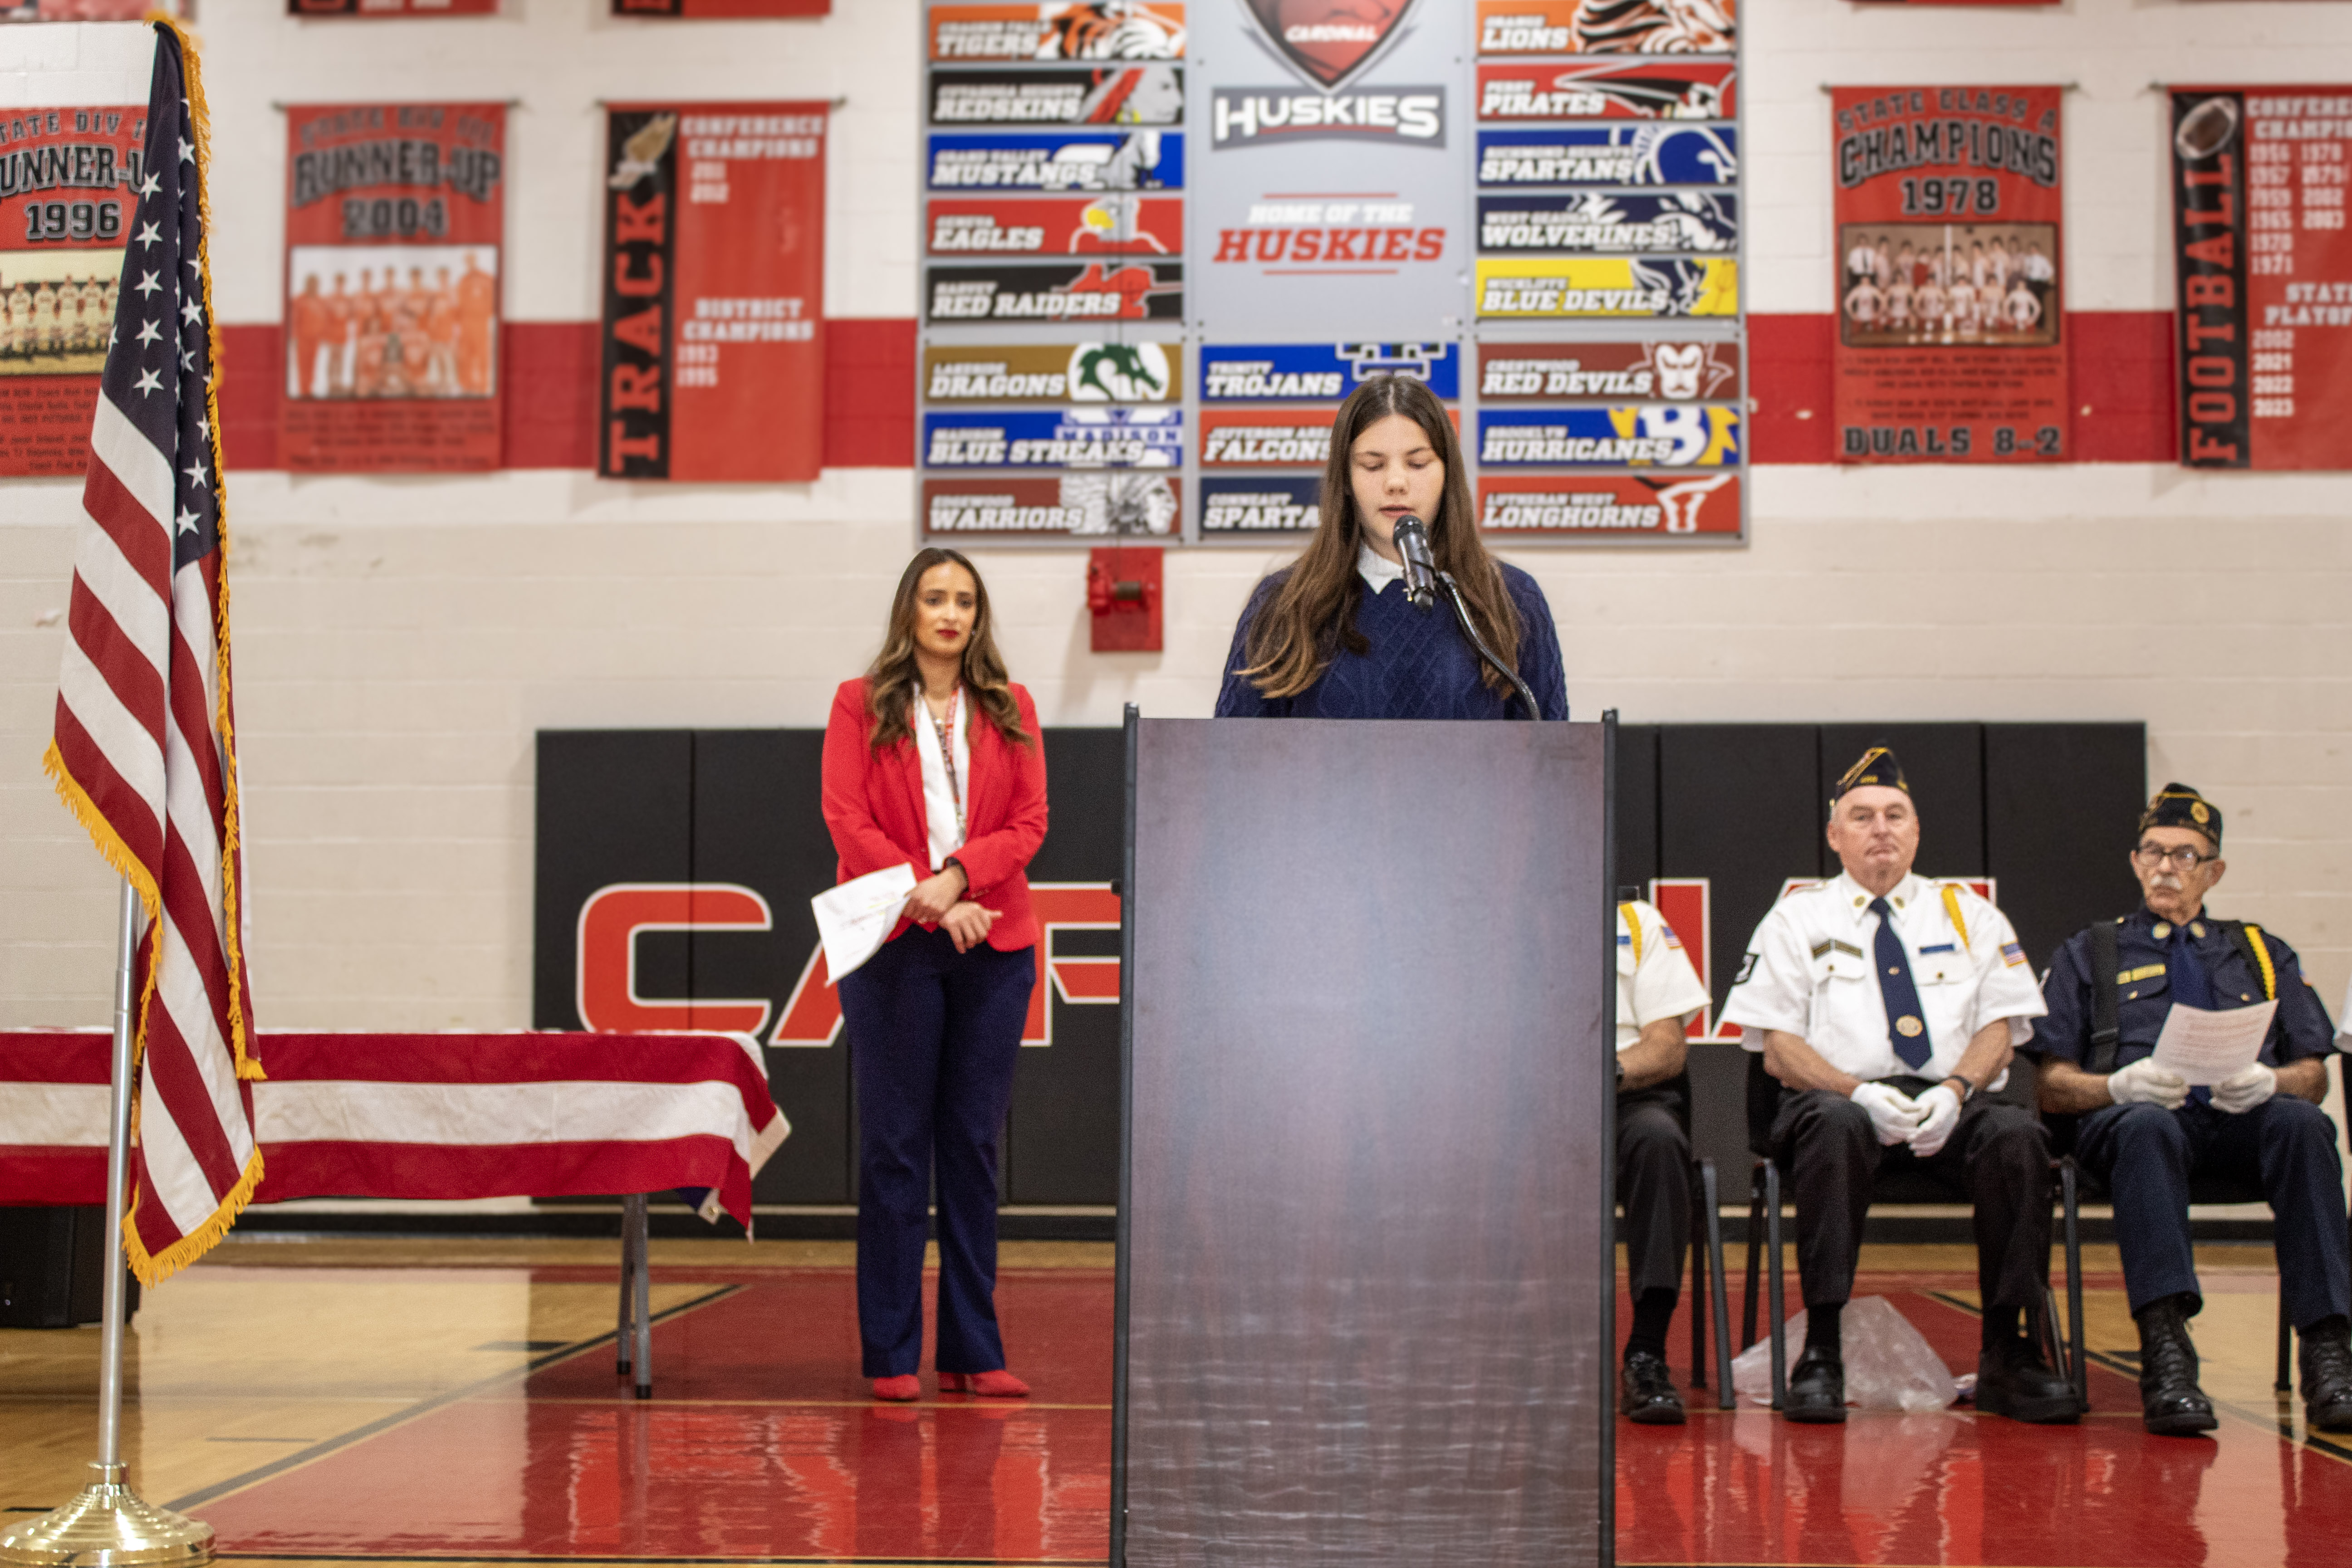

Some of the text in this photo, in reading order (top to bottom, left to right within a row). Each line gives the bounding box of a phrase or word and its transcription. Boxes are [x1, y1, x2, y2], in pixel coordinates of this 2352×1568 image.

[1285, 24, 1377, 42] CARDINAL
[1480, 27, 1569, 50] LIONS
[936, 33, 1039, 57] TIGERS
[934, 98, 1081, 121] REDSKINS
[1480, 92, 1605, 115] PIRATES
[1838, 92, 1925, 131] STATE
[1940, 89, 2028, 121] CLASS
[74, 109, 122, 136] DIV
[681, 115, 824, 136] CONFERENCE
[1215, 95, 1440, 141] HUSKIES
[687, 138, 818, 159] CHAMPIONS
[1838, 119, 2058, 189] CHAMPIONS
[291, 138, 501, 210] RUNNER-UP
[932, 163, 1095, 186] MUSTANGS
[1480, 158, 1633, 181] SPARTANS
[1899, 176, 1999, 215] 1978
[24, 199, 122, 239] 1996
[1248, 204, 1413, 225] HOME OF THE
[931, 227, 1044, 250] EAGLES
[1212, 228, 1446, 262] HUSKIES
[695, 298, 803, 319] DISTRICT
[931, 293, 1121, 317] RED RAIDERS
[1482, 288, 1669, 311] BLUE DEVILS
[2184, 153, 2237, 461] FOOTBALL
[609, 191, 664, 472] TRACK
[682, 320, 814, 342] CHAMPIONS
[929, 374, 1066, 398] DRAGONS
[1206, 374, 1343, 397] TROJANS
[1481, 371, 1653, 395] RED DEVILS
[1063, 429, 1178, 442] MADISON
[1842, 425, 2062, 456] DUALS 8-2
[928, 439, 1145, 464] BLUE STREAKS
[1480, 438, 1673, 461] HURRICANES
[929, 507, 1084, 530] WARRIORS
[1481, 505, 1661, 528] LONGHORNS
